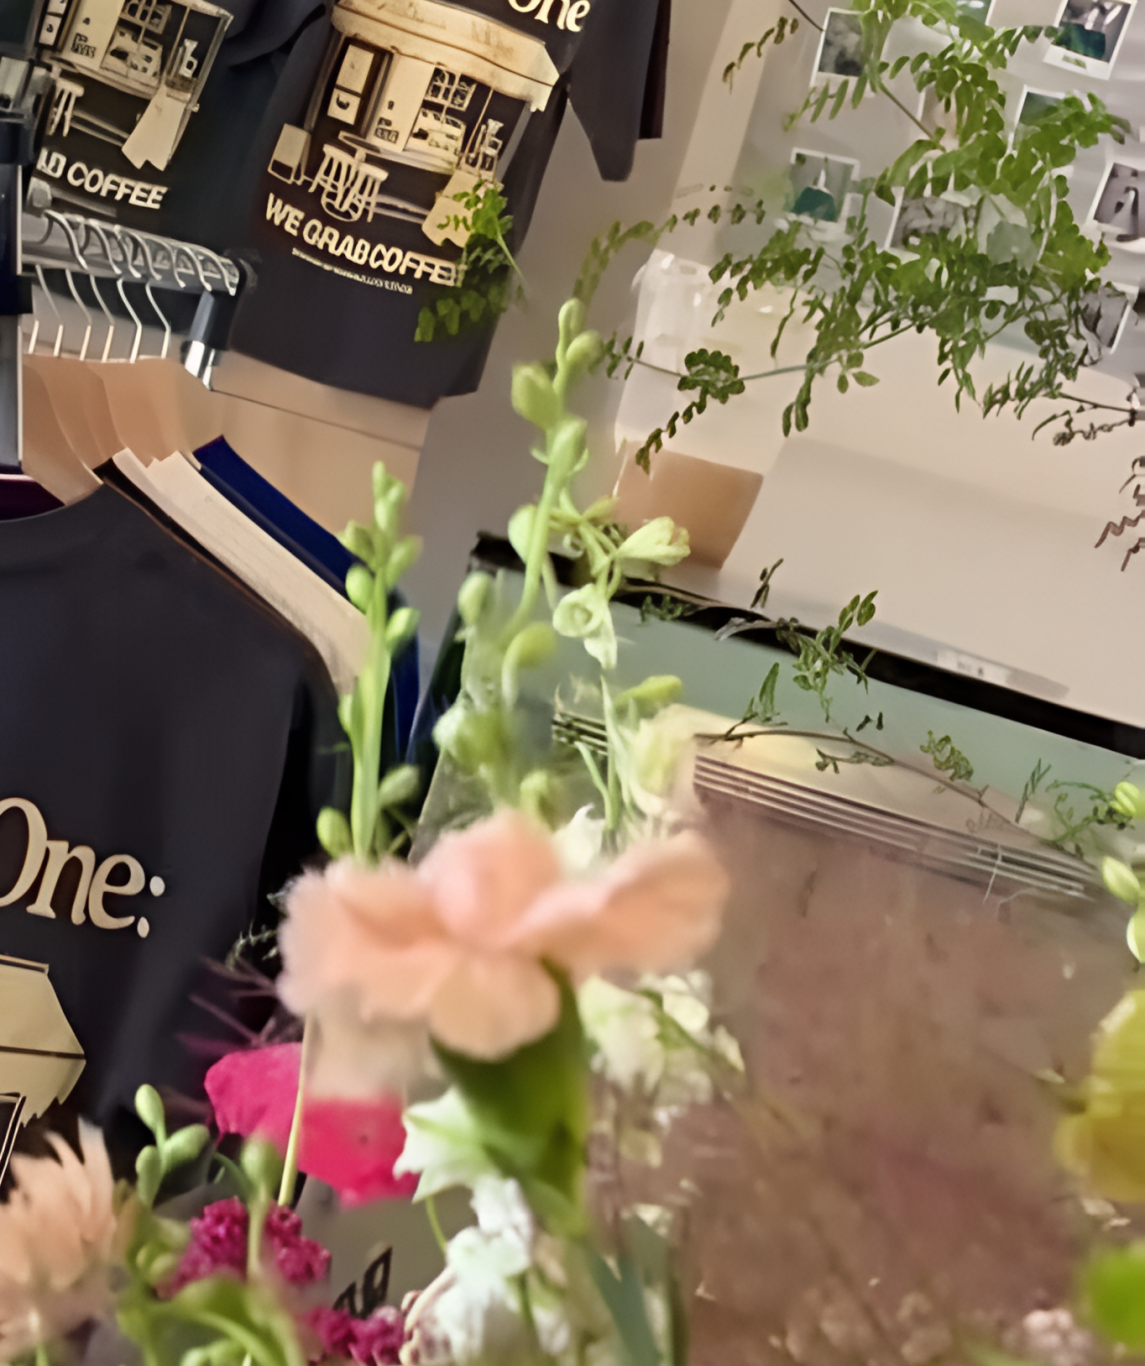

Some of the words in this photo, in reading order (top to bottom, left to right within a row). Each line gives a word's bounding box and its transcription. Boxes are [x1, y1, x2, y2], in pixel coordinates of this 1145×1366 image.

[67, 162, 168, 209] COFFEE
[266, 192, 304, 236] WE
[303, 219, 370, 265] GRAB
